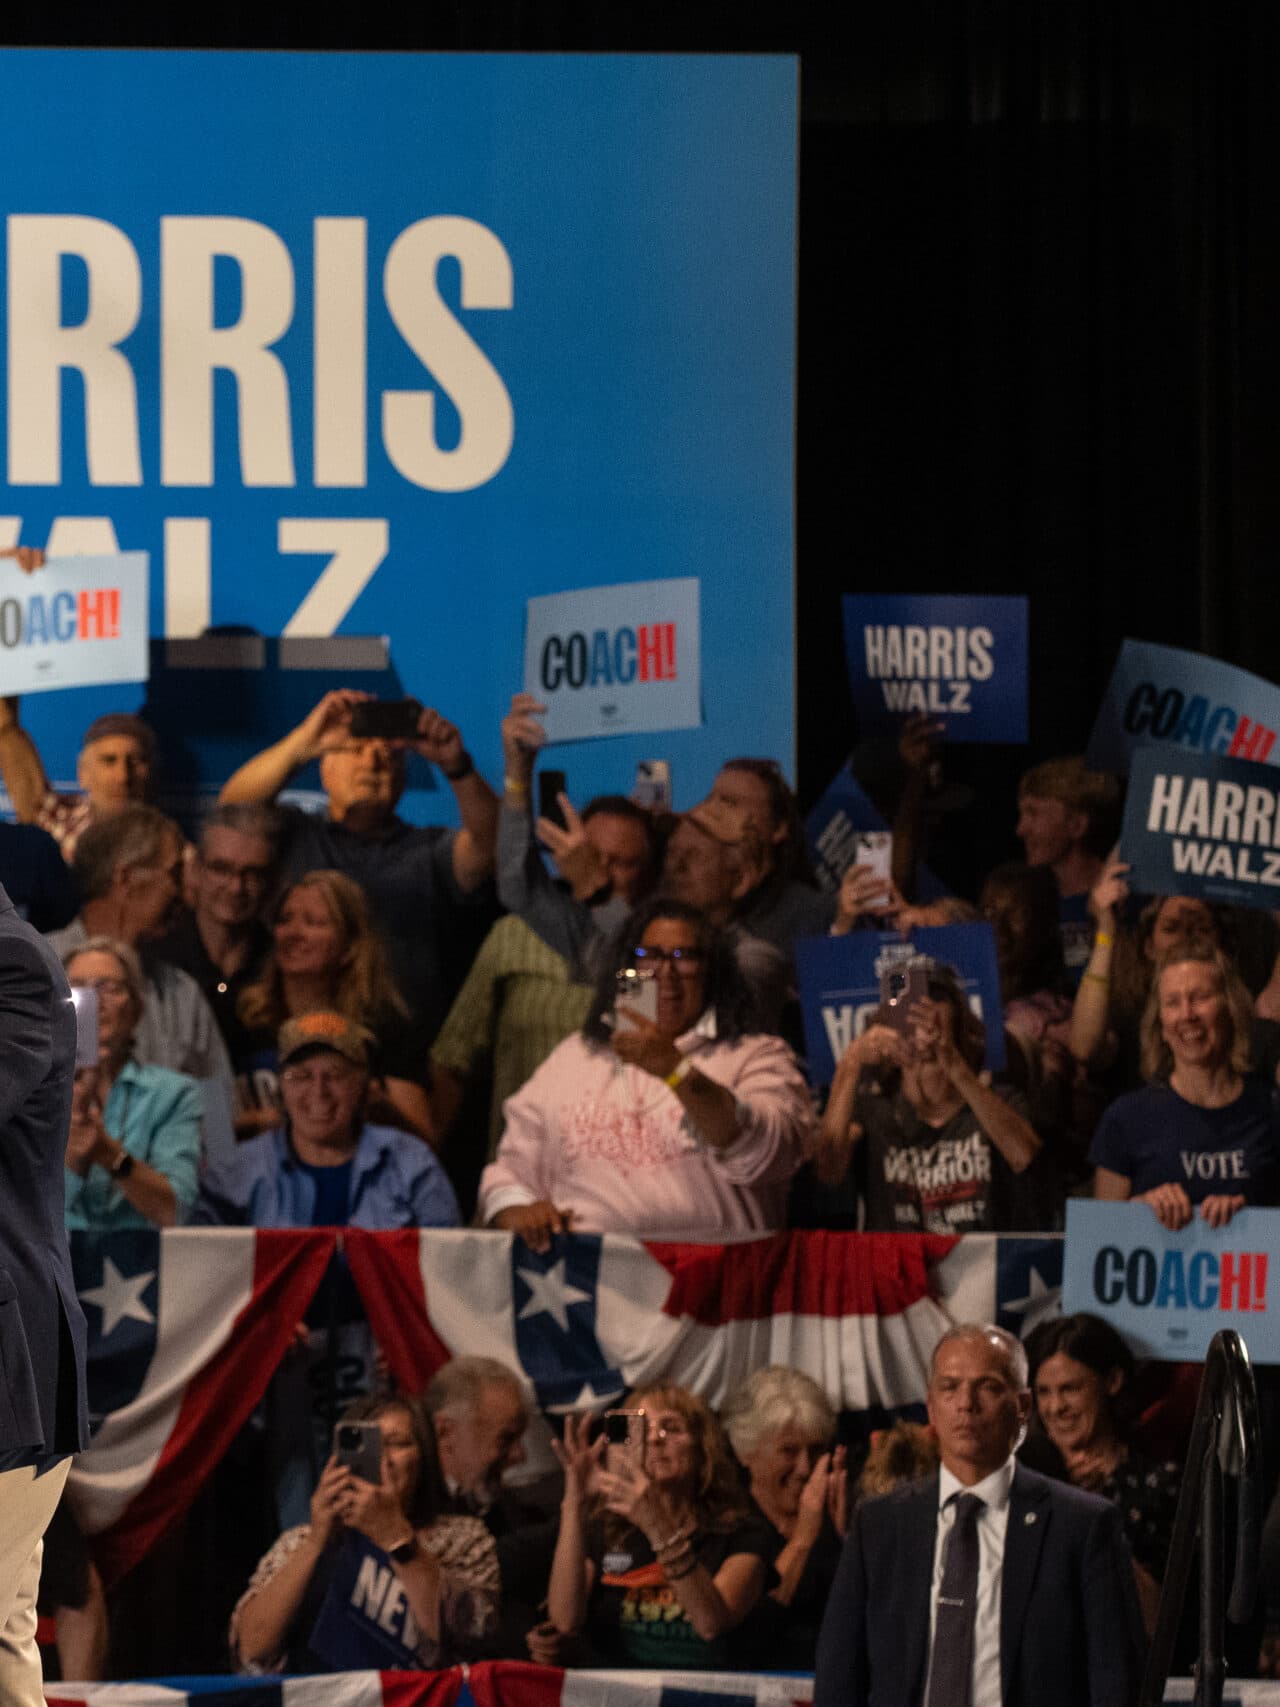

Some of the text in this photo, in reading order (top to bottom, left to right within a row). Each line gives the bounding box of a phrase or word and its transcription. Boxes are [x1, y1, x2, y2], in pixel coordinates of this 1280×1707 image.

[541, 621, 677, 692] COACH!
[864, 624, 994, 681] HARRIS
[881, 680, 972, 714] WALZ
[1173, 838, 1280, 886] WALZ
[1180, 1151, 1249, 1179] VOTE
[1094, 1245, 1268, 1312] COACH!
